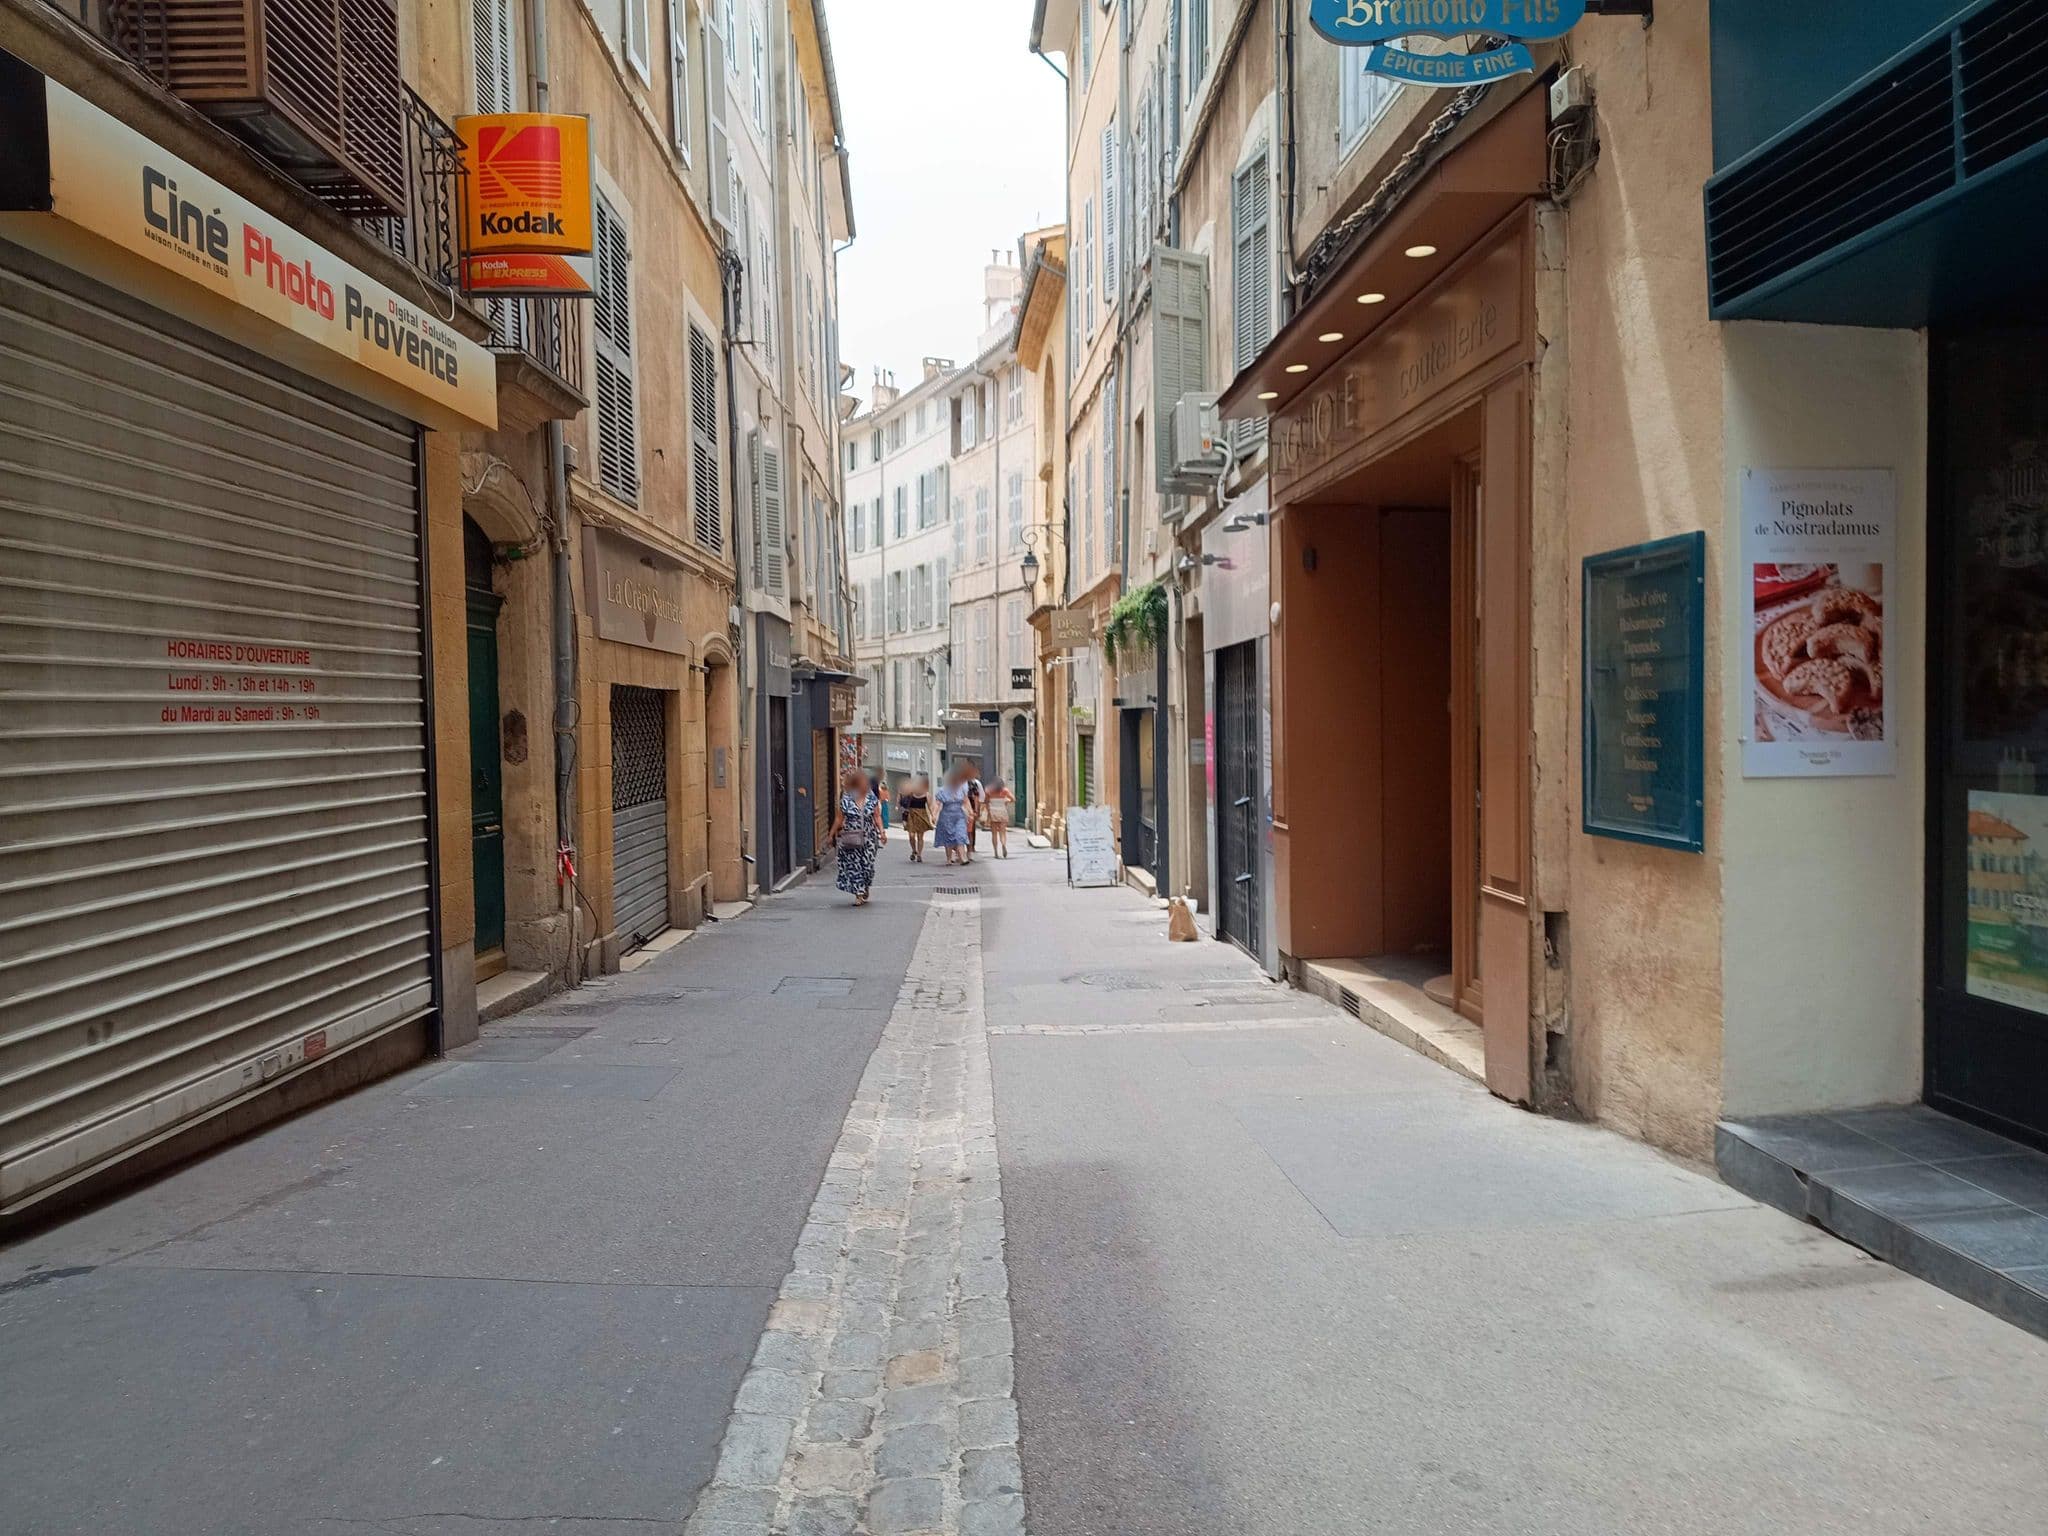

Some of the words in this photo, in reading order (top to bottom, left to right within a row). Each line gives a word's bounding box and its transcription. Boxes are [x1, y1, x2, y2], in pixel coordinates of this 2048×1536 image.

[1473, 51, 1516, 73] FINE
[480, 211, 565, 236] Kodak
[144, 227, 172, 249] Maison
[202, 258, 211, 270] en
[482, 260, 509, 270] Kodak
[494, 268, 548, 280] EXPRESS
[143, 166, 229, 265] Ciné
[243, 222, 335, 321] Photo
[345, 284, 458, 388] Provence
[388, 298, 419, 328] Digital
[422, 320, 457, 352] Solution
[1400, 301, 1497, 399] coutellerie
[1781, 500, 1854, 519] Pignolats
[1755, 524, 1770, 536] de
[1773, 520, 1881, 537] Nostradamus
[605, 569, 622, 606] La
[168, 641, 233, 661] HORAIRES
[236, 646, 310, 665] D'OUVERTURE
[168, 673, 202, 691] Lundi
[212, 676, 226, 691] 9h
[237, 677, 256, 692] 13h
[259, 679, 269, 692] et
[272, 679, 289, 693] 14h
[299, 679, 315, 694] 19h
[161, 706, 177, 722] du
[181, 706, 214, 722] Mardi
[218, 711, 231, 722] au
[235, 706, 273, 722] Samedi
[282, 707, 295, 721] 9h
[303, 707, 320, 721] 19h
